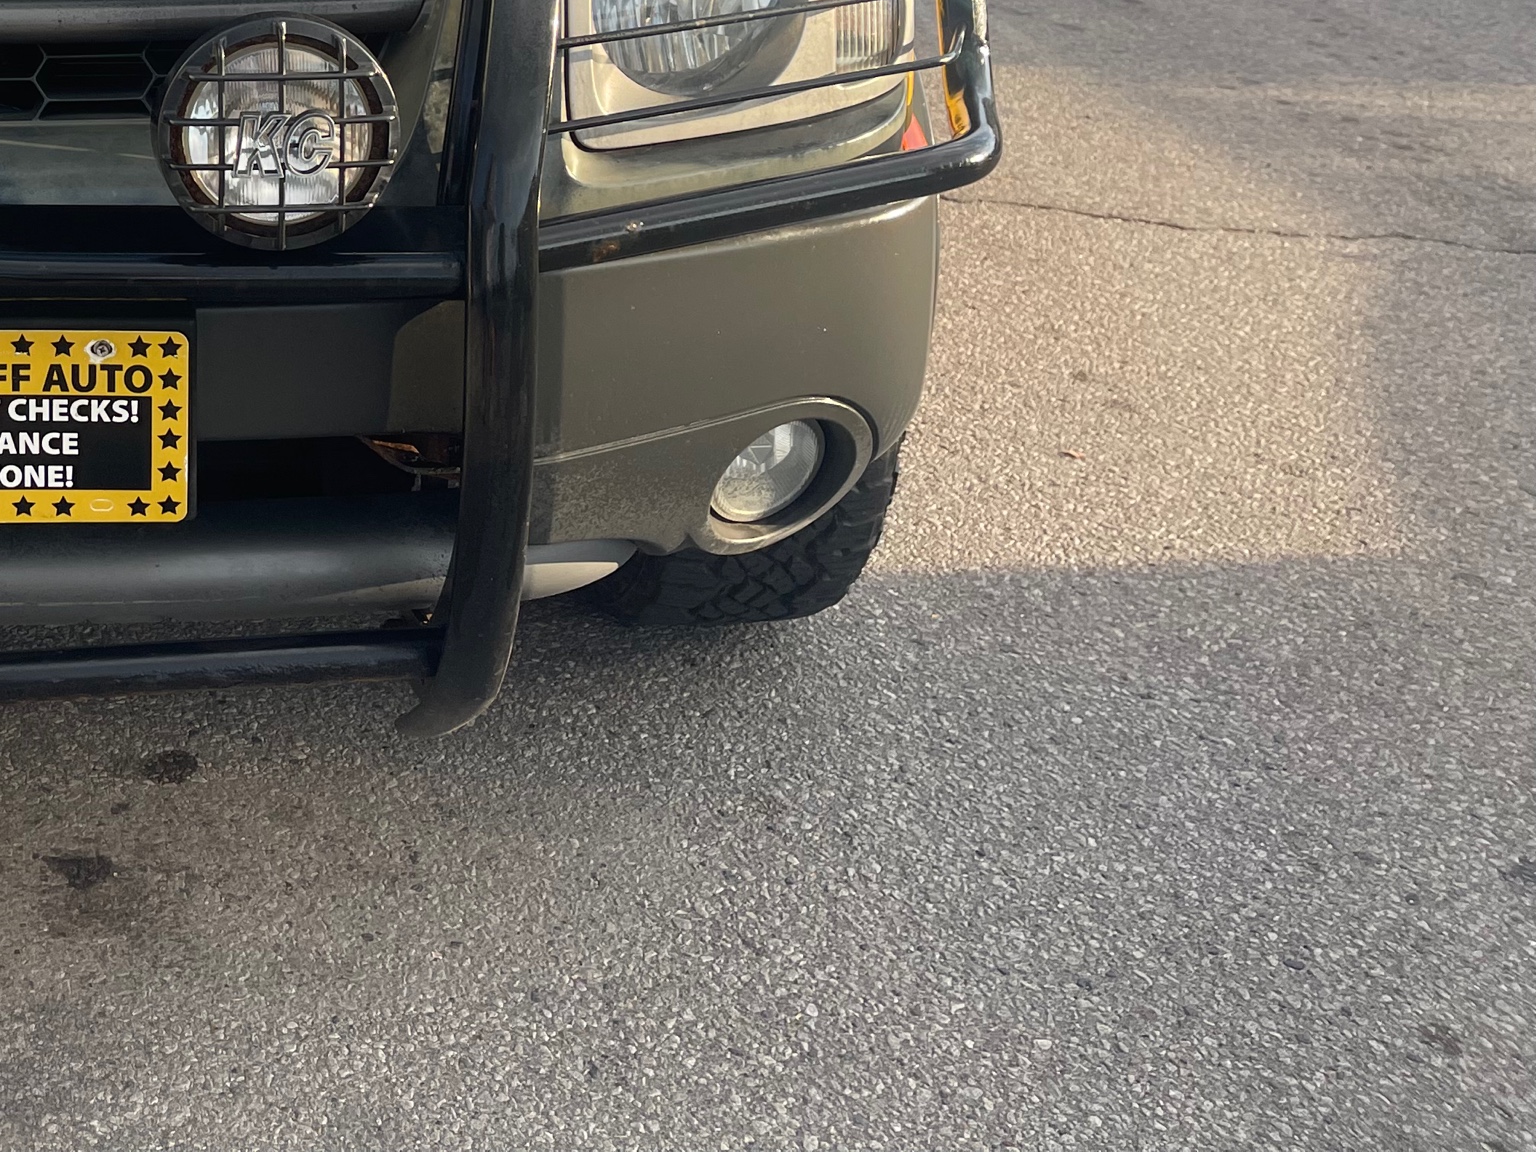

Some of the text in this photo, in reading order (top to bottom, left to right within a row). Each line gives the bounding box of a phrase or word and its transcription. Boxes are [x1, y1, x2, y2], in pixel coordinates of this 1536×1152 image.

[232, 109, 335, 178] KC
[42, 363, 153, 394] AUTO
[7, 398, 139, 424] CHECKS!
